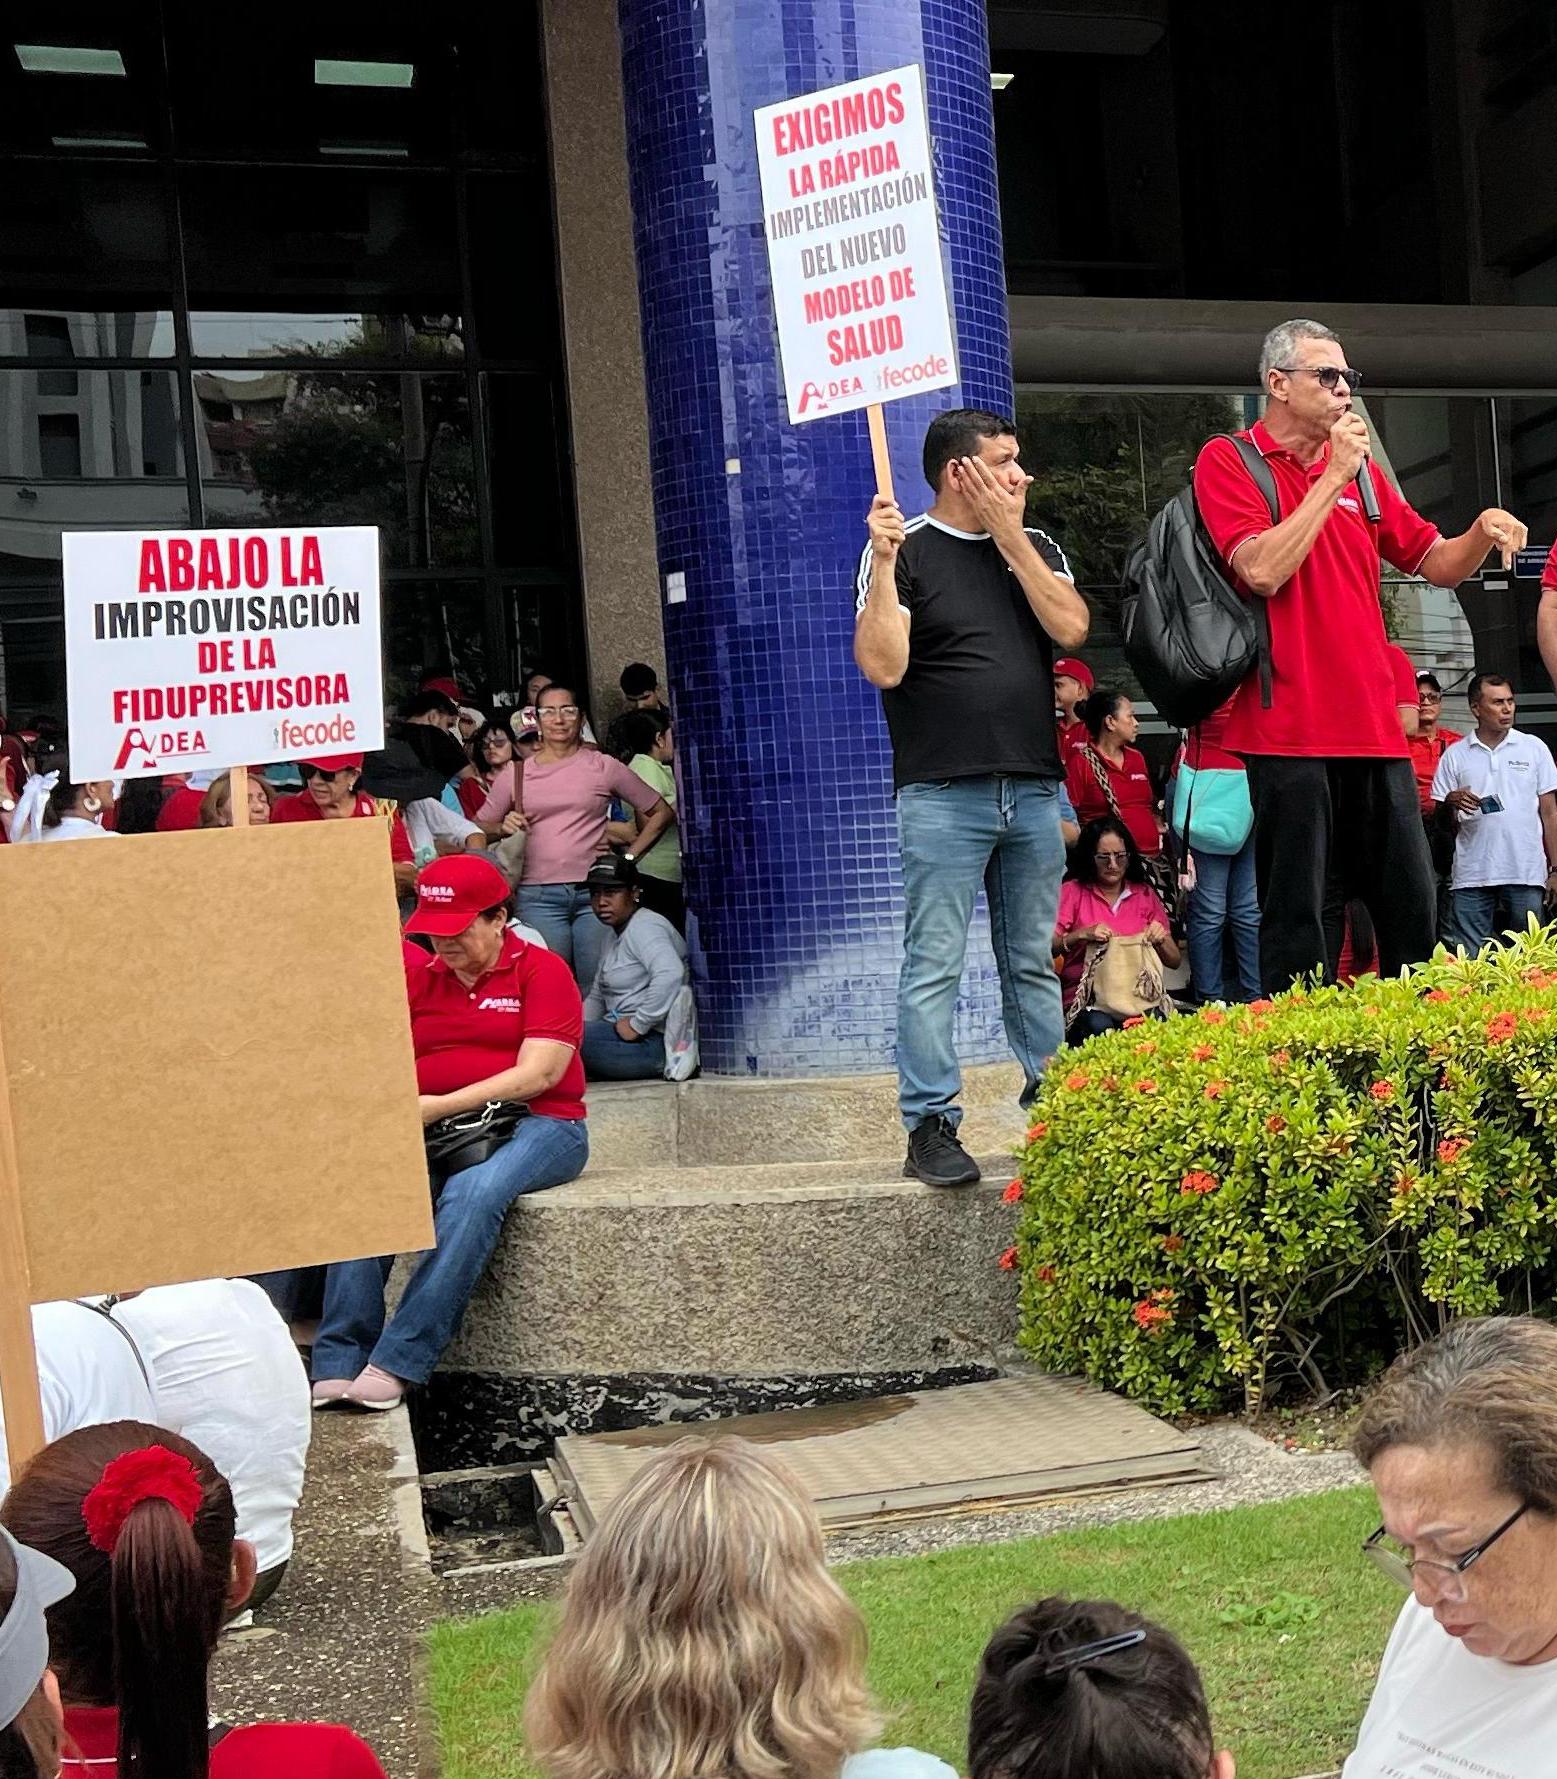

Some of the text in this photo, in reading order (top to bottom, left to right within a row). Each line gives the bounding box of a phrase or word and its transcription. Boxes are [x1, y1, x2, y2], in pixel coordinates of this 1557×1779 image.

[772, 82, 905, 157] EXIGIMOS
[788, 140, 900, 198] LA RÁPIDA
[770, 171, 927, 240] IMPLEMENTACIÓN
[801, 223, 906, 279] DEL NUEVO
[804, 267, 916, 324] MODELO DE
[827, 314, 903, 366] SALUD
[882, 354, 948, 389] fecode
[138, 535, 324, 593] ABAJO LA
[94, 585, 361, 640] IMPROVISACIÓN
[198, 638, 276, 674] DE LA
[113, 673, 350, 724] FIDUPREVISORA
[281, 713, 355, 749] fecode
